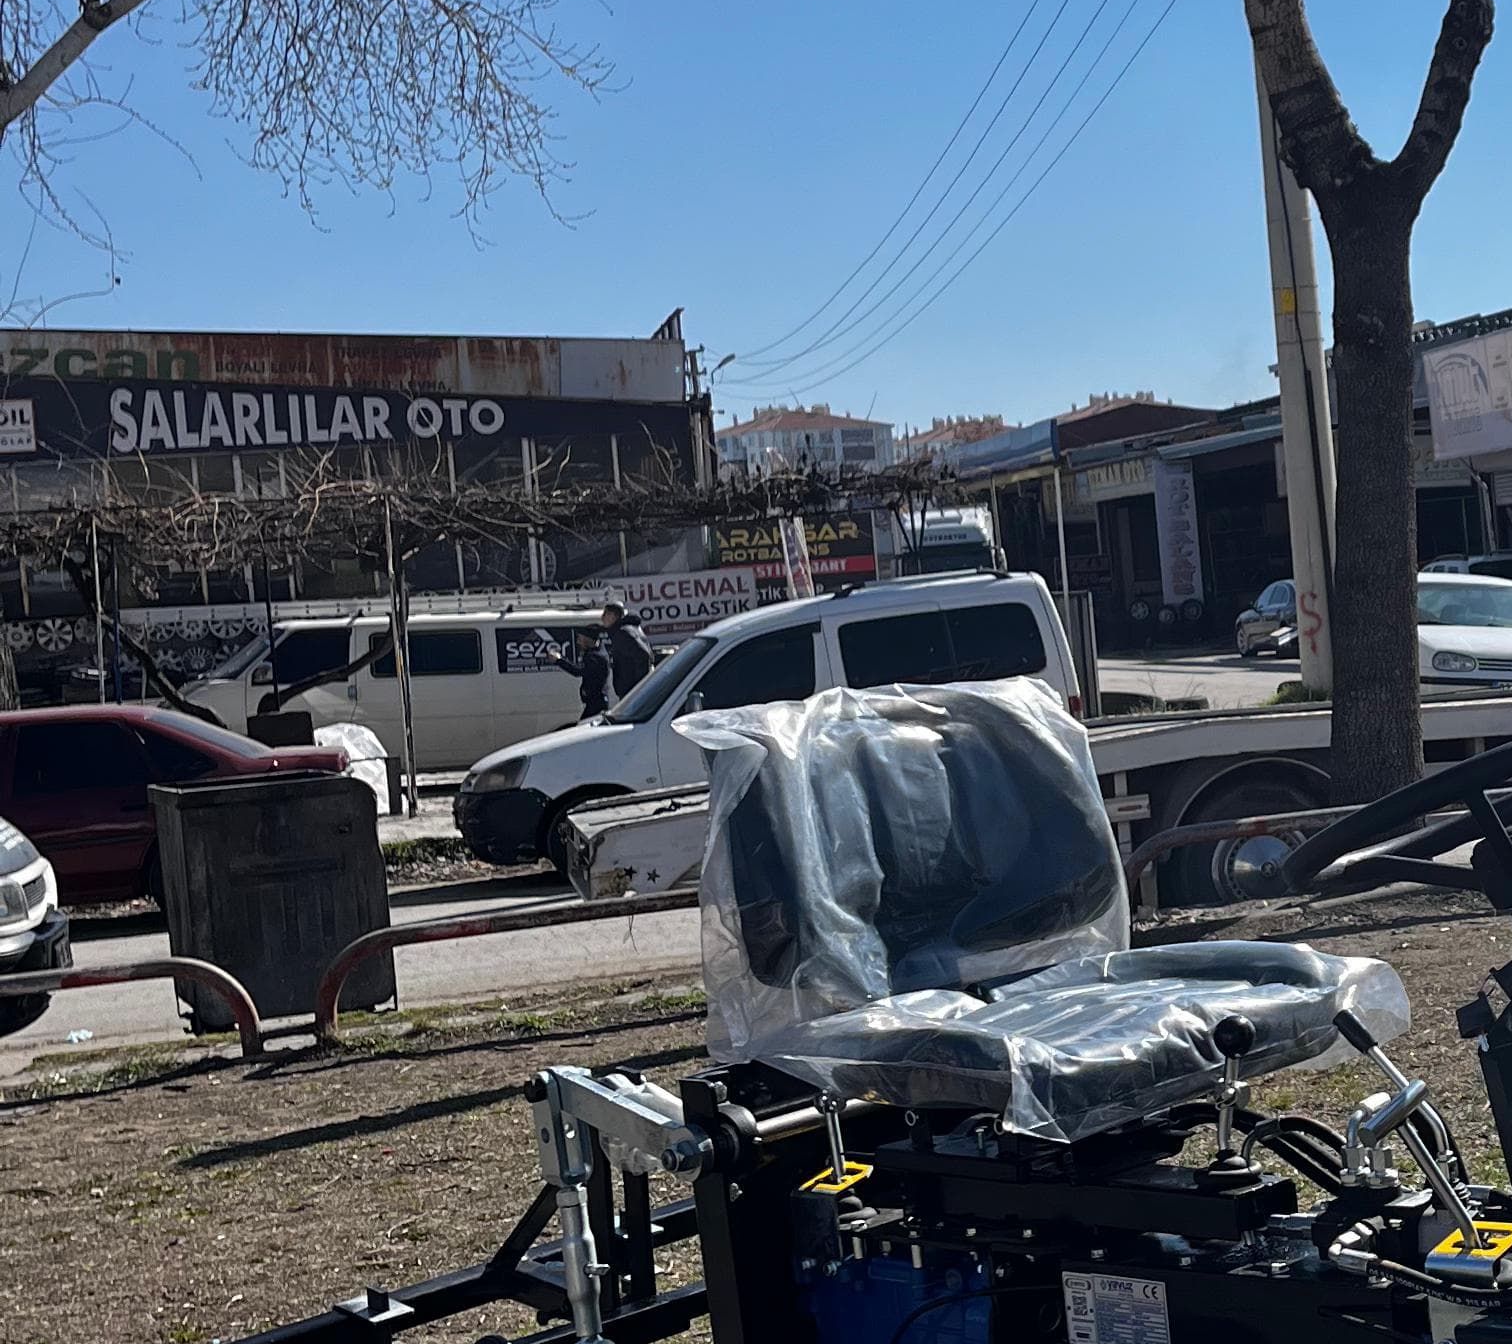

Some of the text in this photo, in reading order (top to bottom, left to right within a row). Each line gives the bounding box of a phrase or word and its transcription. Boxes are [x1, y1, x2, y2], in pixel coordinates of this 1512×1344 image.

[0, 346, 201, 378] zcan
[109, 387, 505, 454] SALARLILAR OTO
[625, 575, 750, 603] ÜLCEMAL
[640, 597, 750, 621] OTO LASTİK
